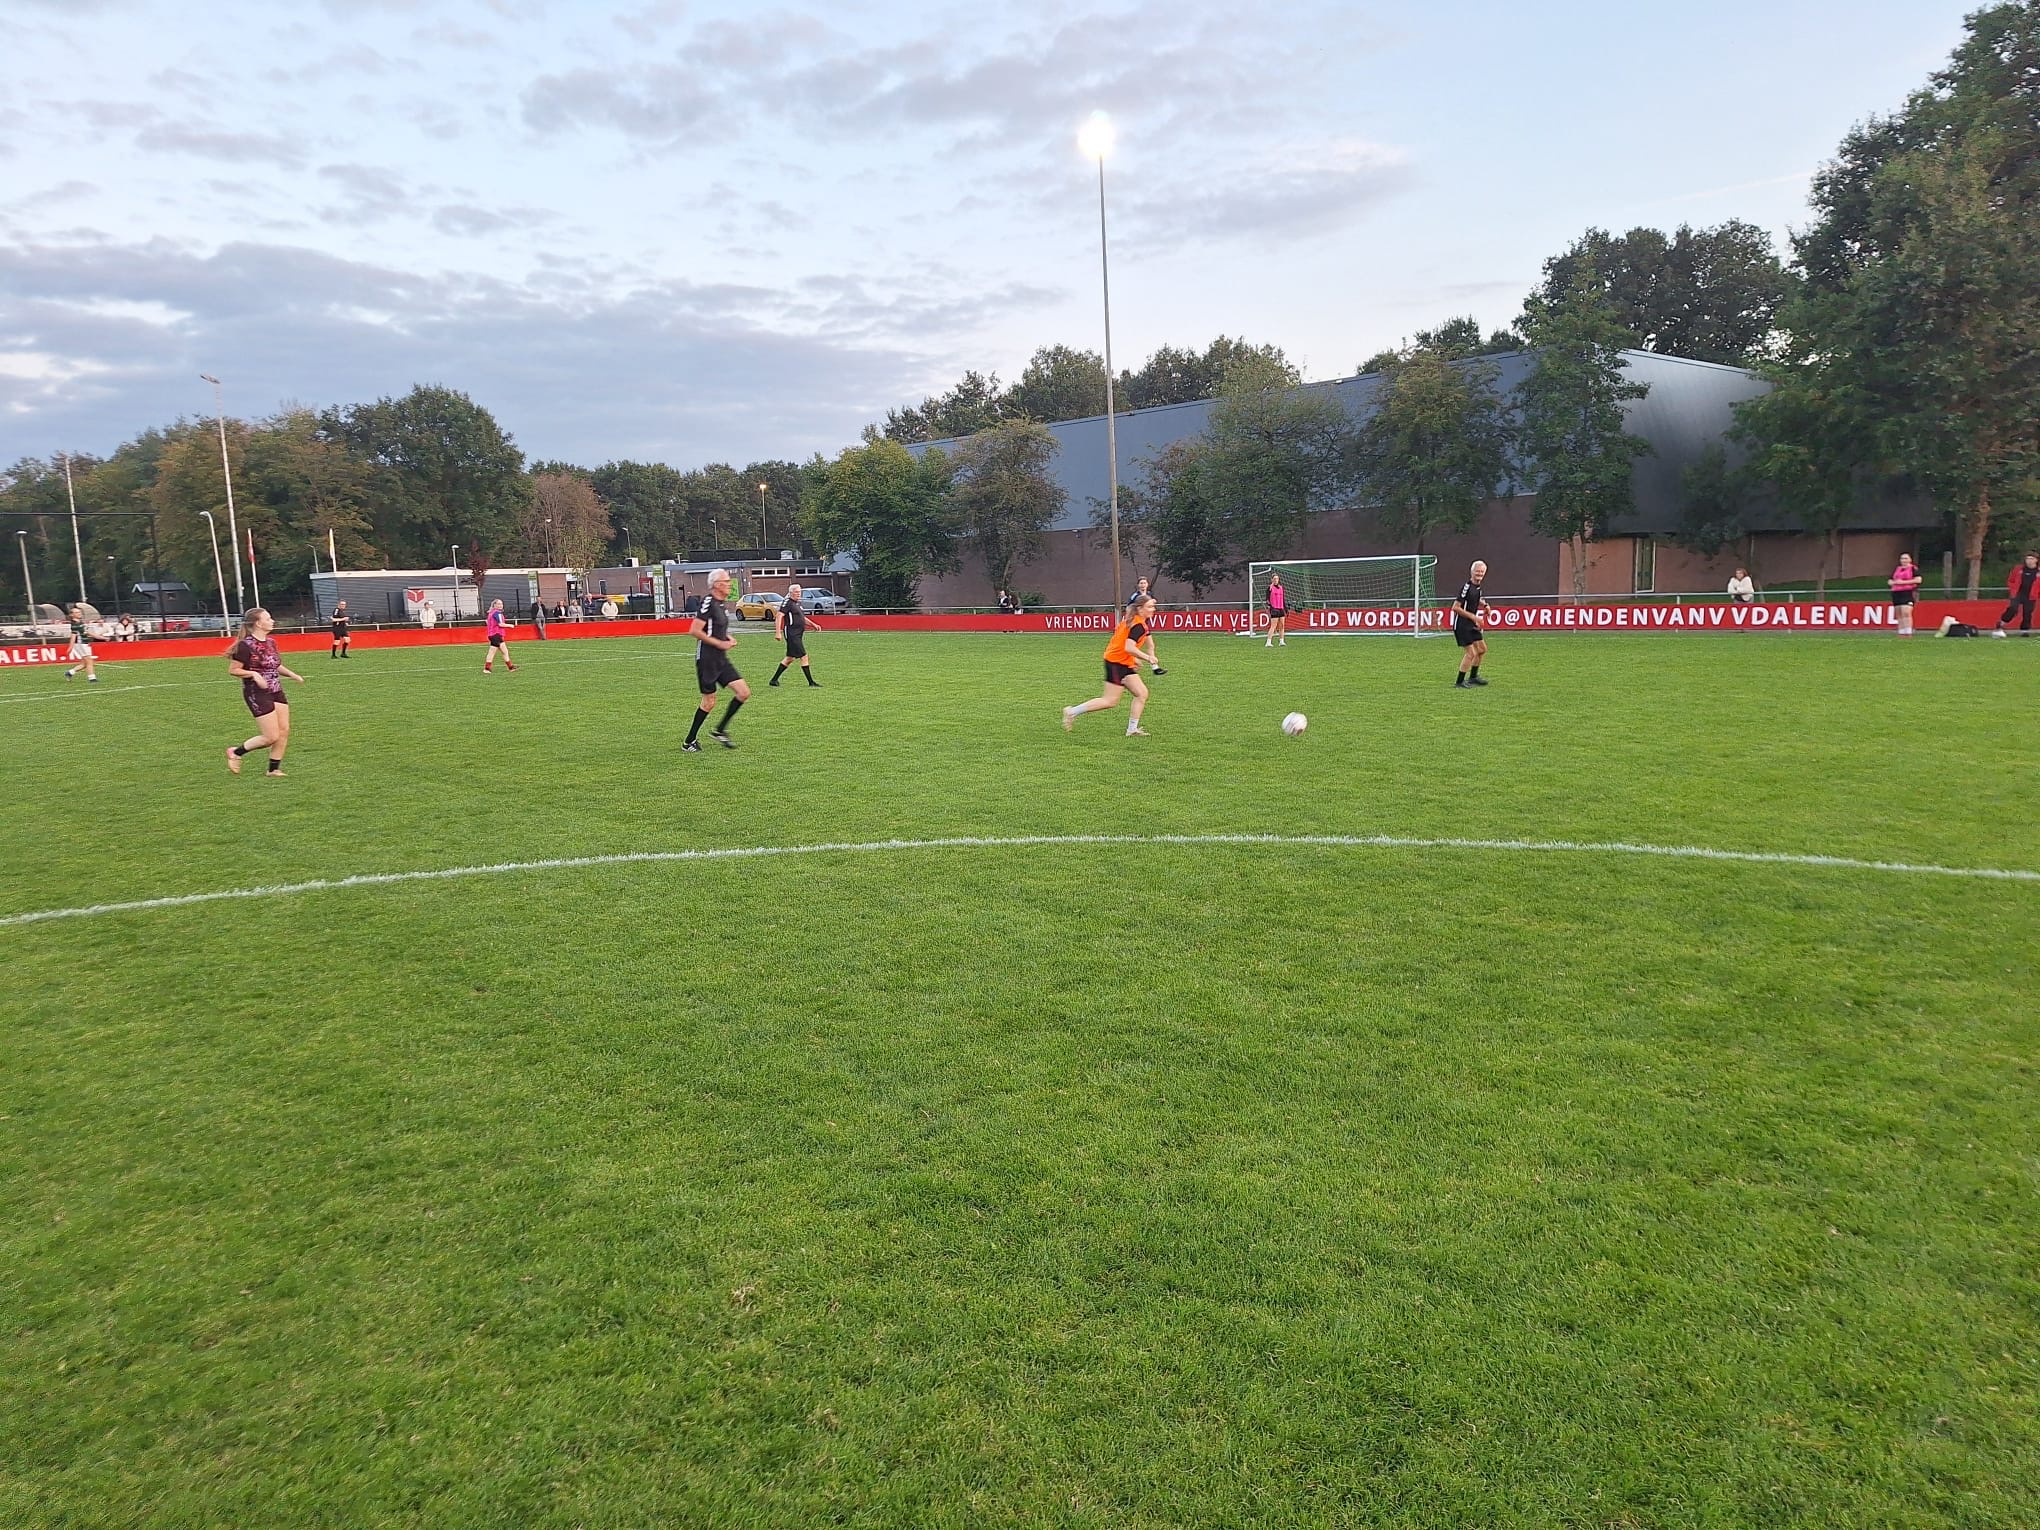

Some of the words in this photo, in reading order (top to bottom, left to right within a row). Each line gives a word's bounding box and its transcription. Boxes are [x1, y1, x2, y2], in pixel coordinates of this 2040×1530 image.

[1045, 615, 1110, 629] VRIENDEN
[1149, 614, 1168, 628] VV
[1174, 613, 1223, 628] DALEN
[1309, 611, 1339, 627] LID
[1346, 610, 1444, 627] WORDEN?
